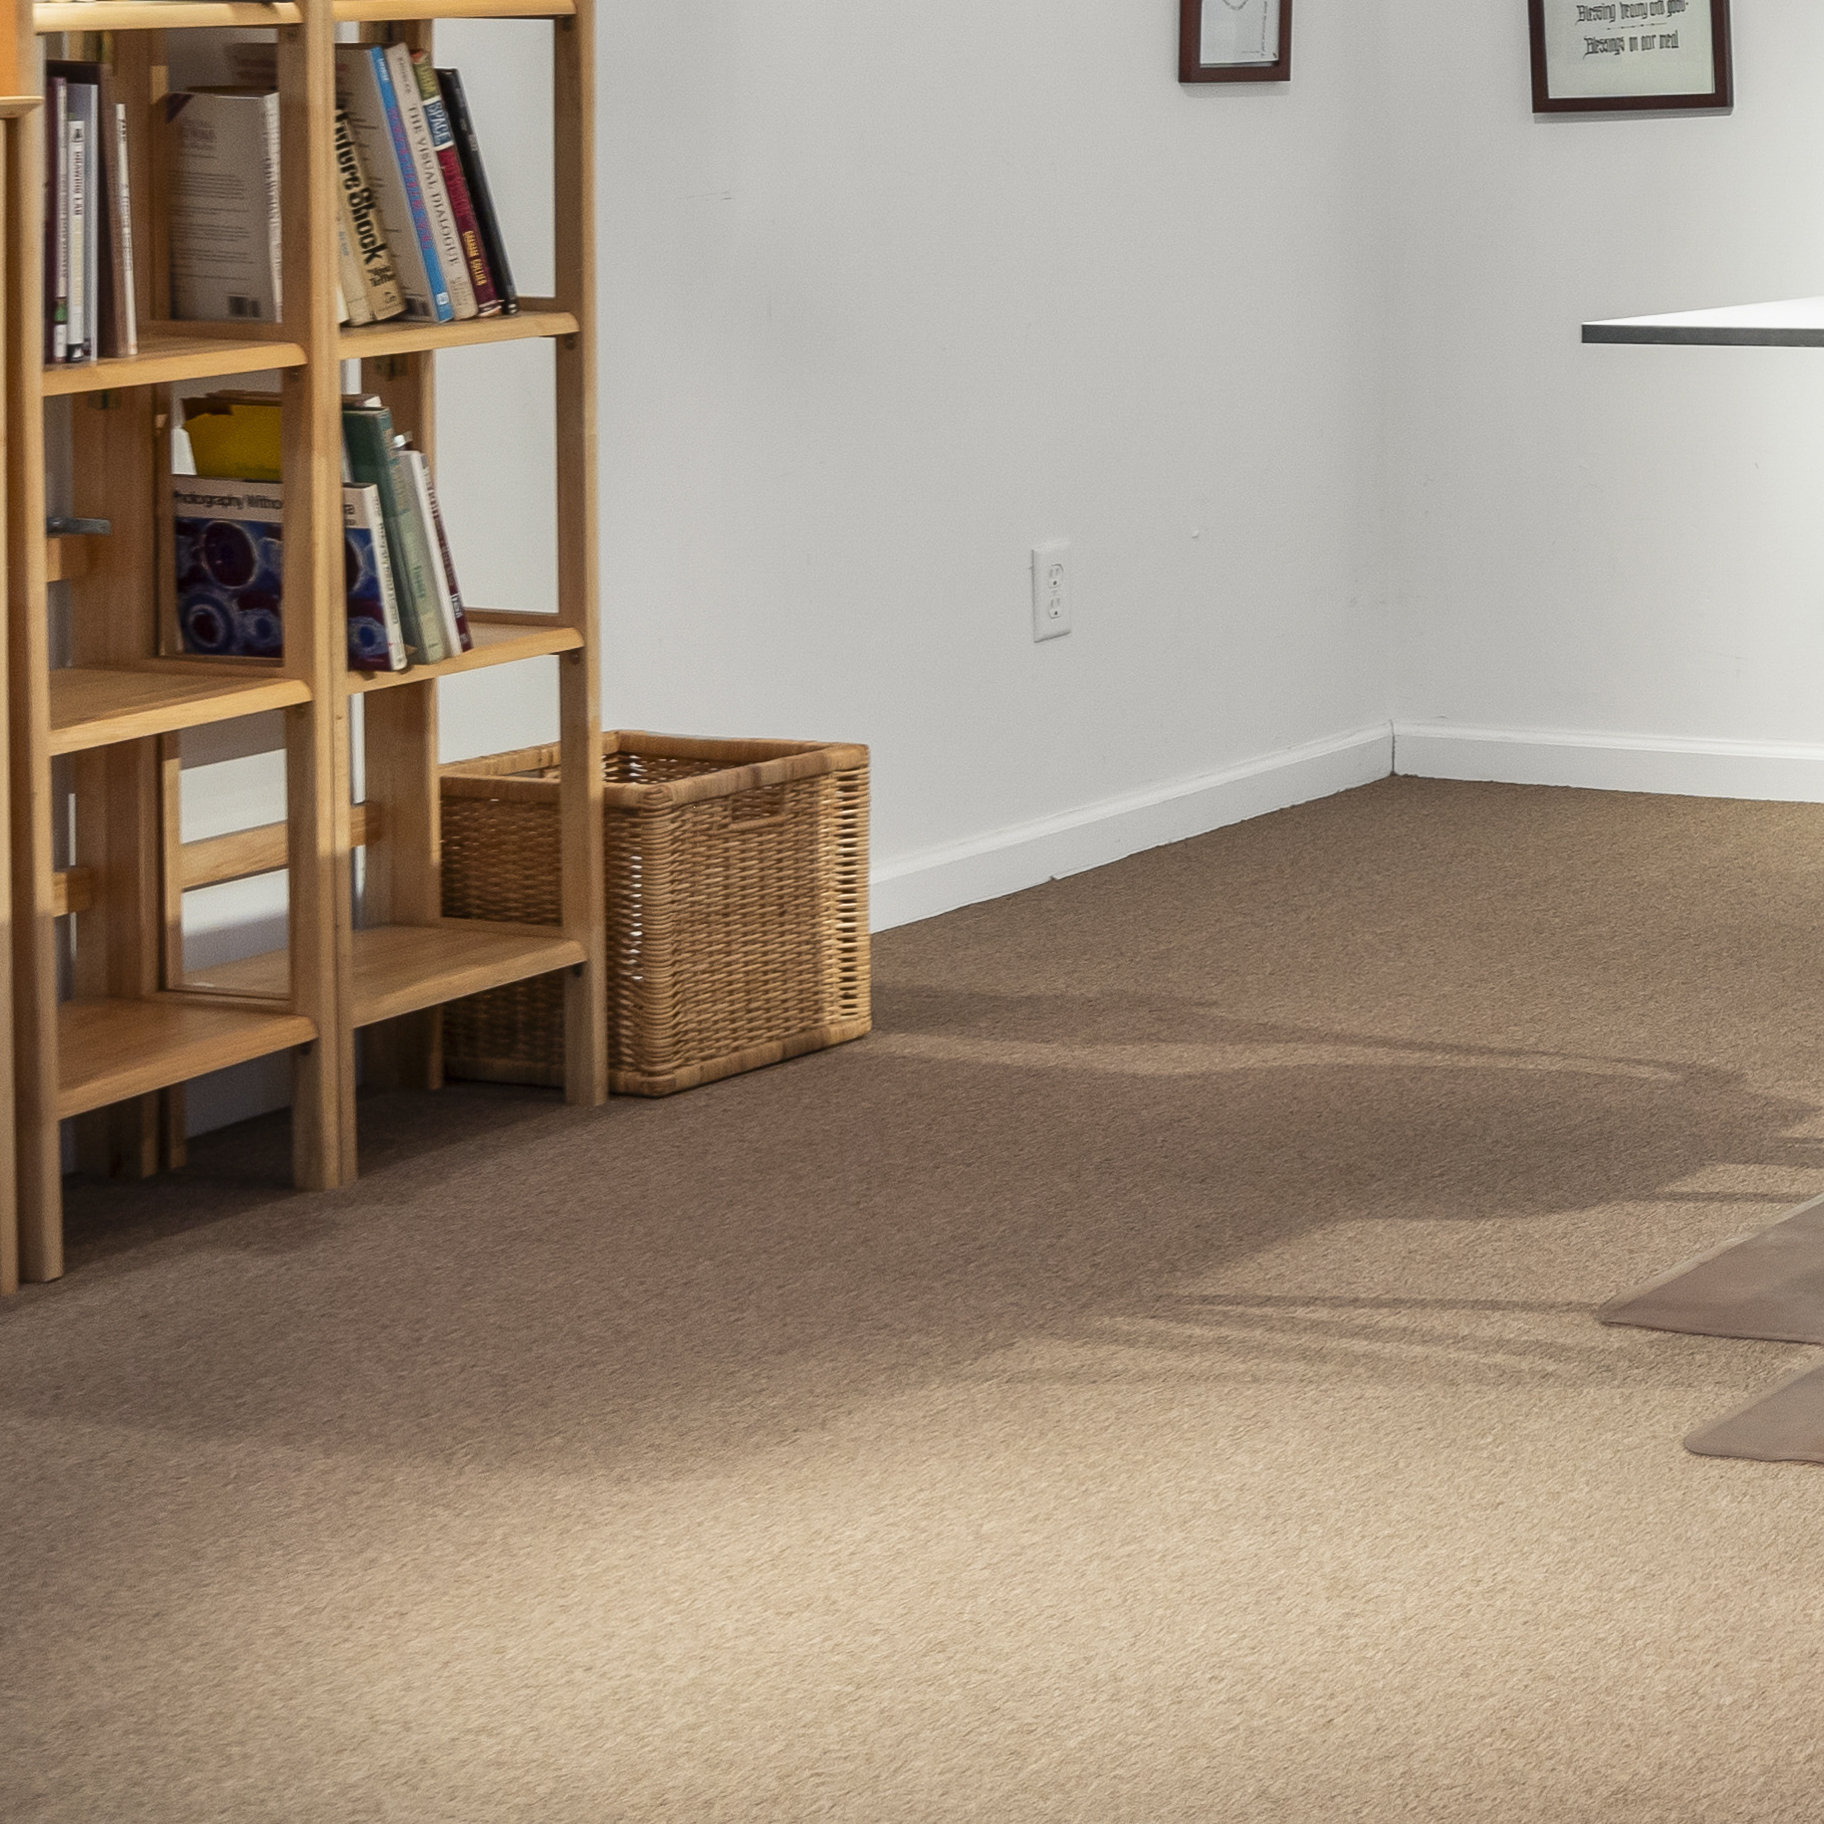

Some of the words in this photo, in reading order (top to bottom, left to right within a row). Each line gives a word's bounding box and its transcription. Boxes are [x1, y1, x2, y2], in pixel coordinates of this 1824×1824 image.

[408, 104, 424, 134] THE
[415, 138, 441, 190] VISUAL
[344, 186, 392, 265] Shock
[431, 192, 460, 267] DIALOGUE
